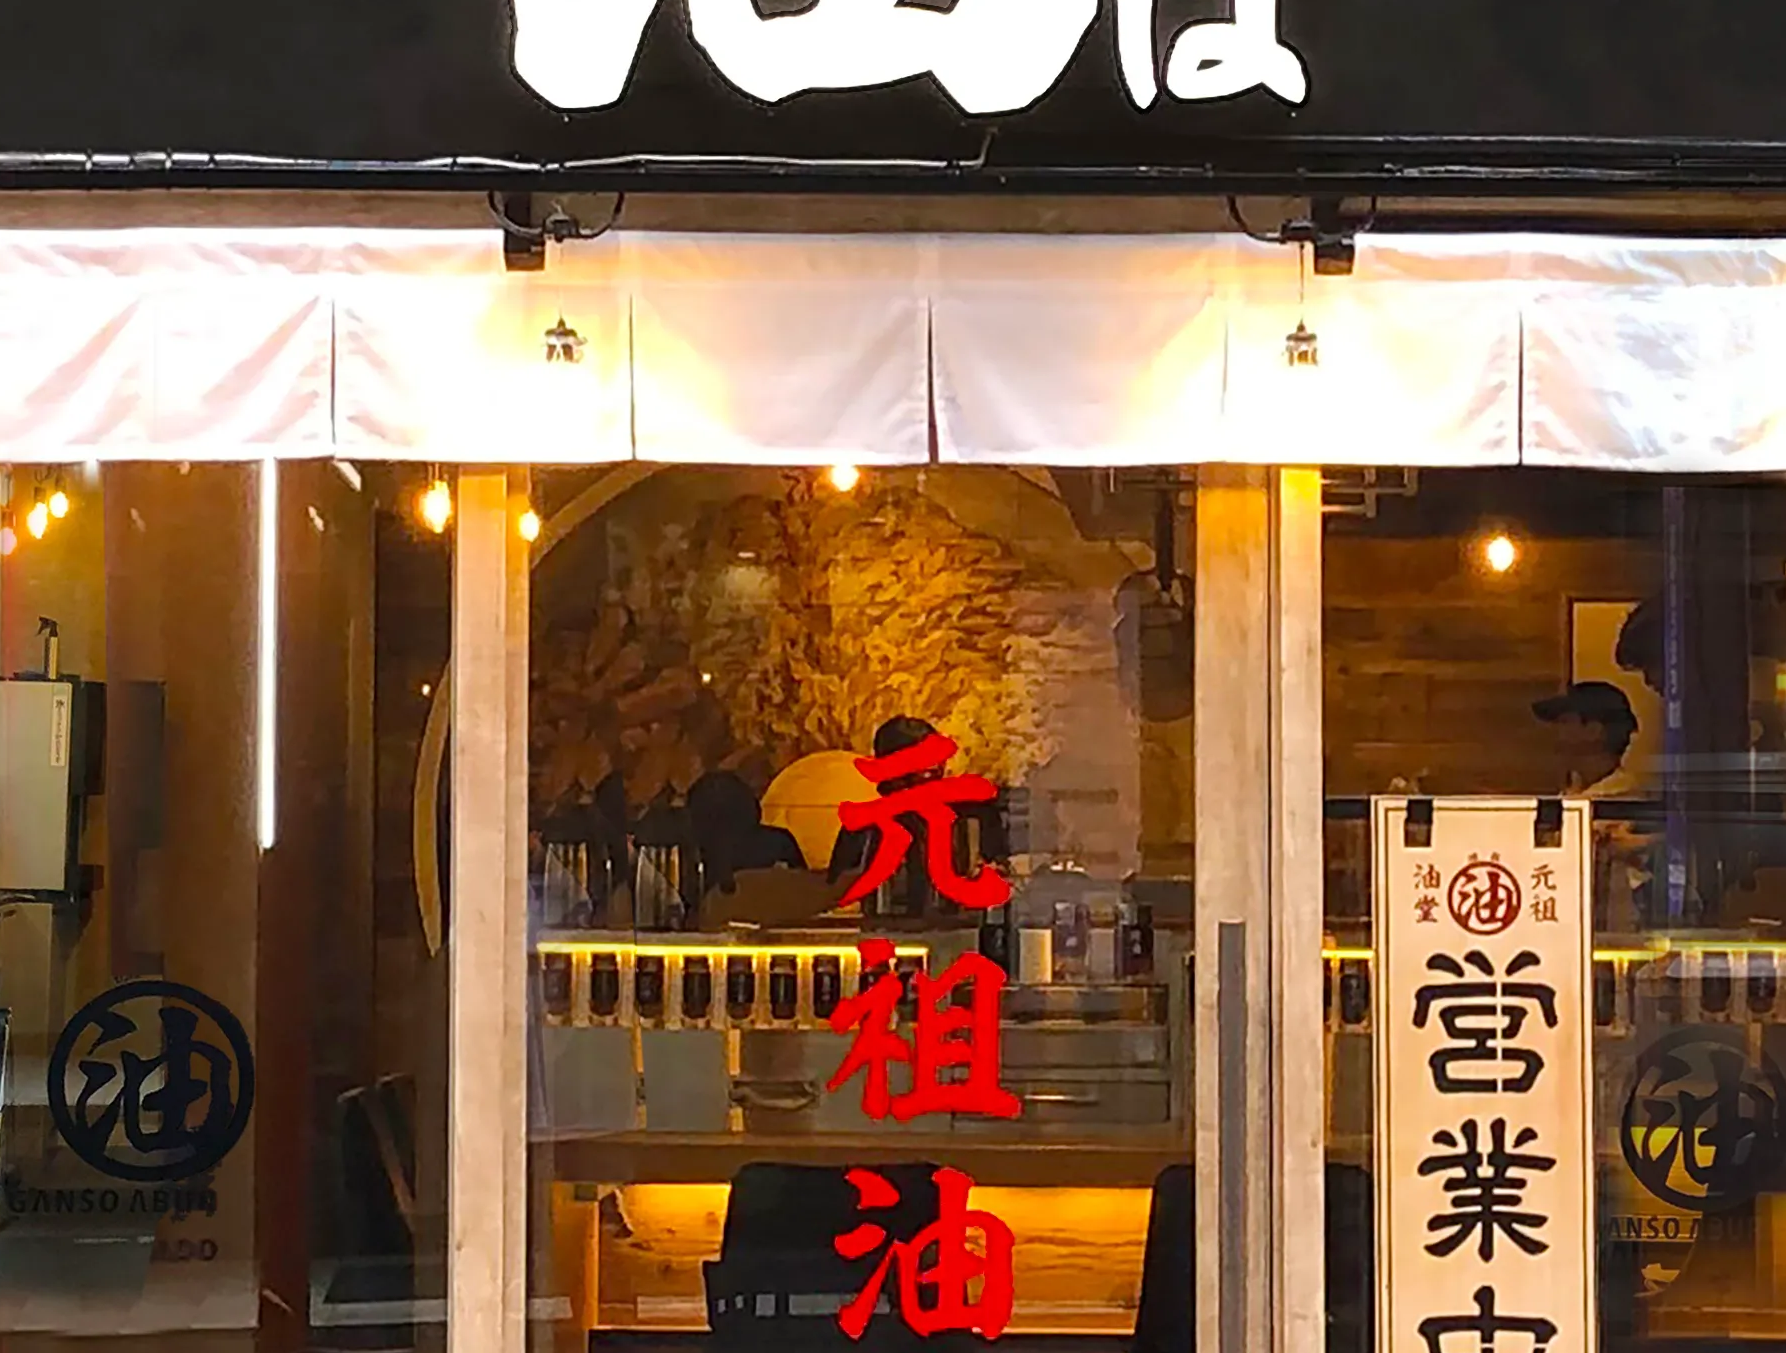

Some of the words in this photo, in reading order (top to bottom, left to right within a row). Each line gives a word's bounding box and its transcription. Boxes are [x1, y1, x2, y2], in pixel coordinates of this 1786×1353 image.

[1453, 868, 1520, 932] 油
[69, 1000, 241, 1162] 油
[7, 1188, 119, 1214] GANSO
